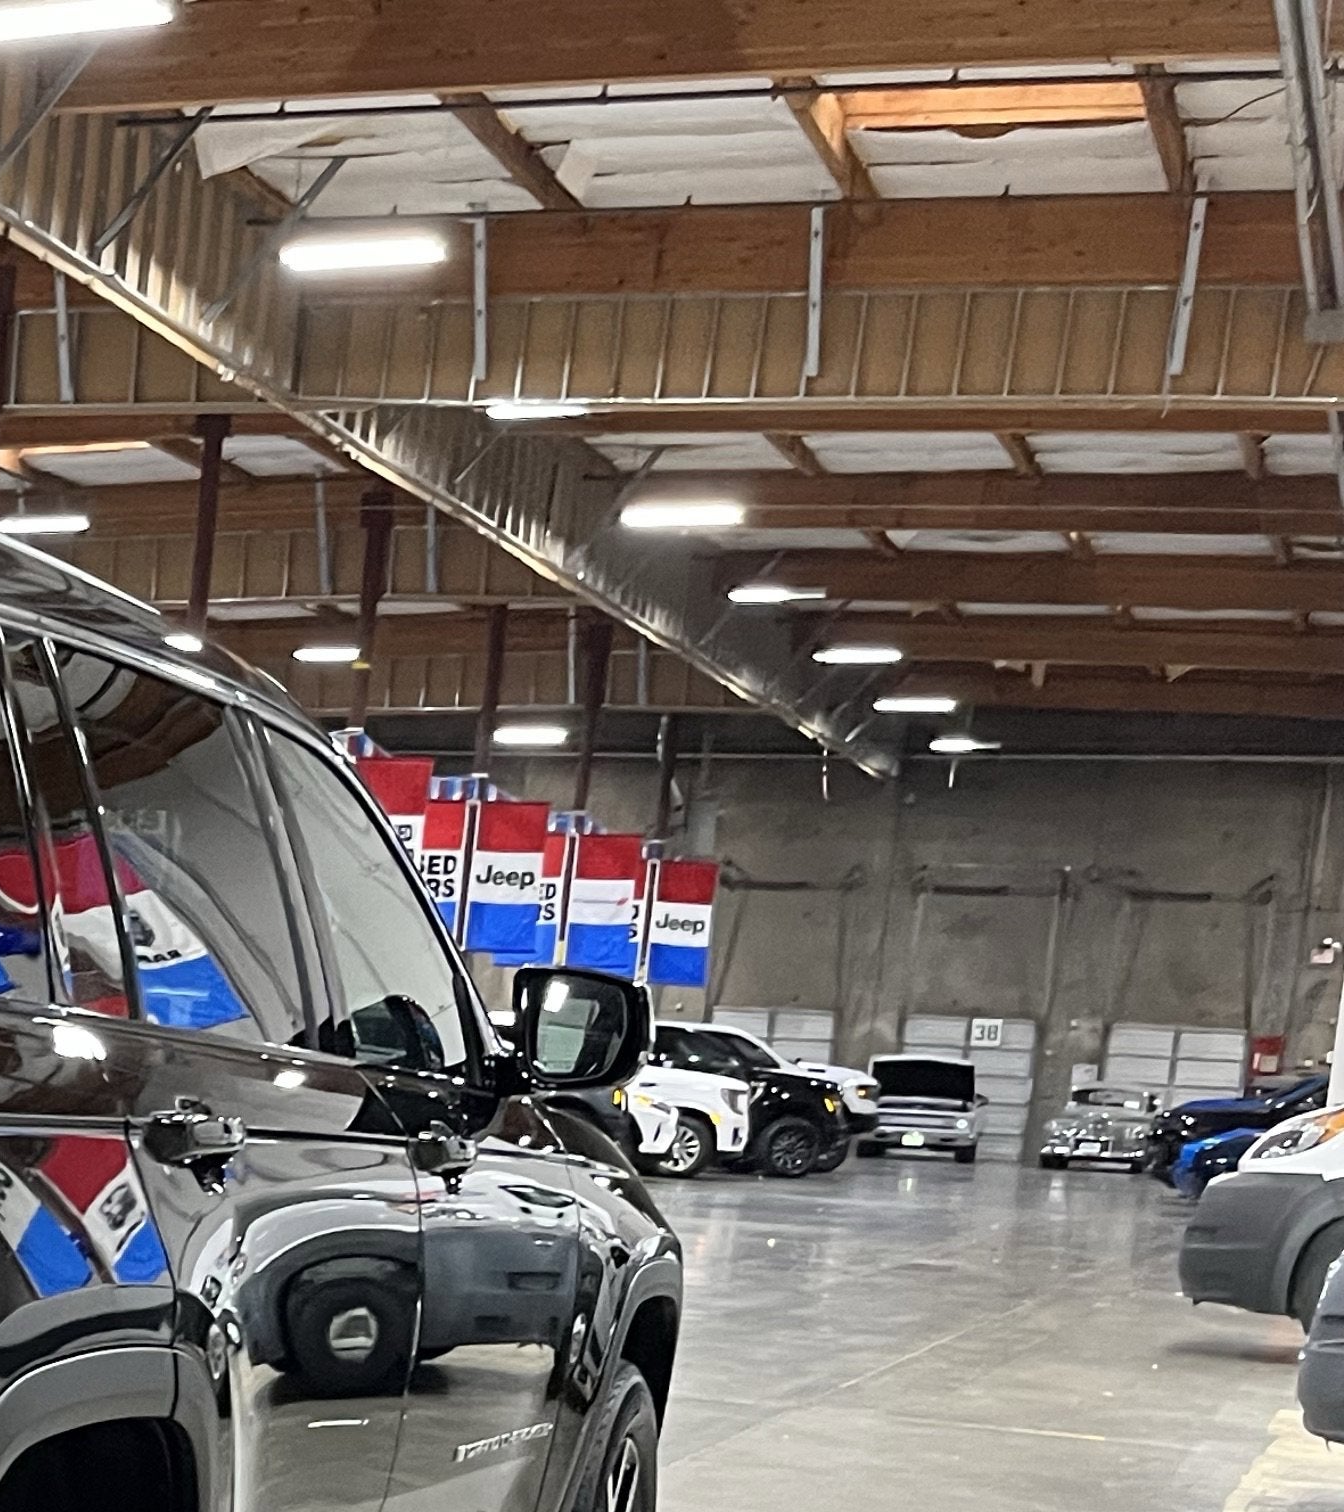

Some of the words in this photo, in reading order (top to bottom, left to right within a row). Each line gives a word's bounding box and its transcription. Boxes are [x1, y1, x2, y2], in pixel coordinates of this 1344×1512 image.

[475, 864, 535, 890] Jeep
[655, 913, 706, 935] Jeep
[974, 1024, 999, 1041] 38
